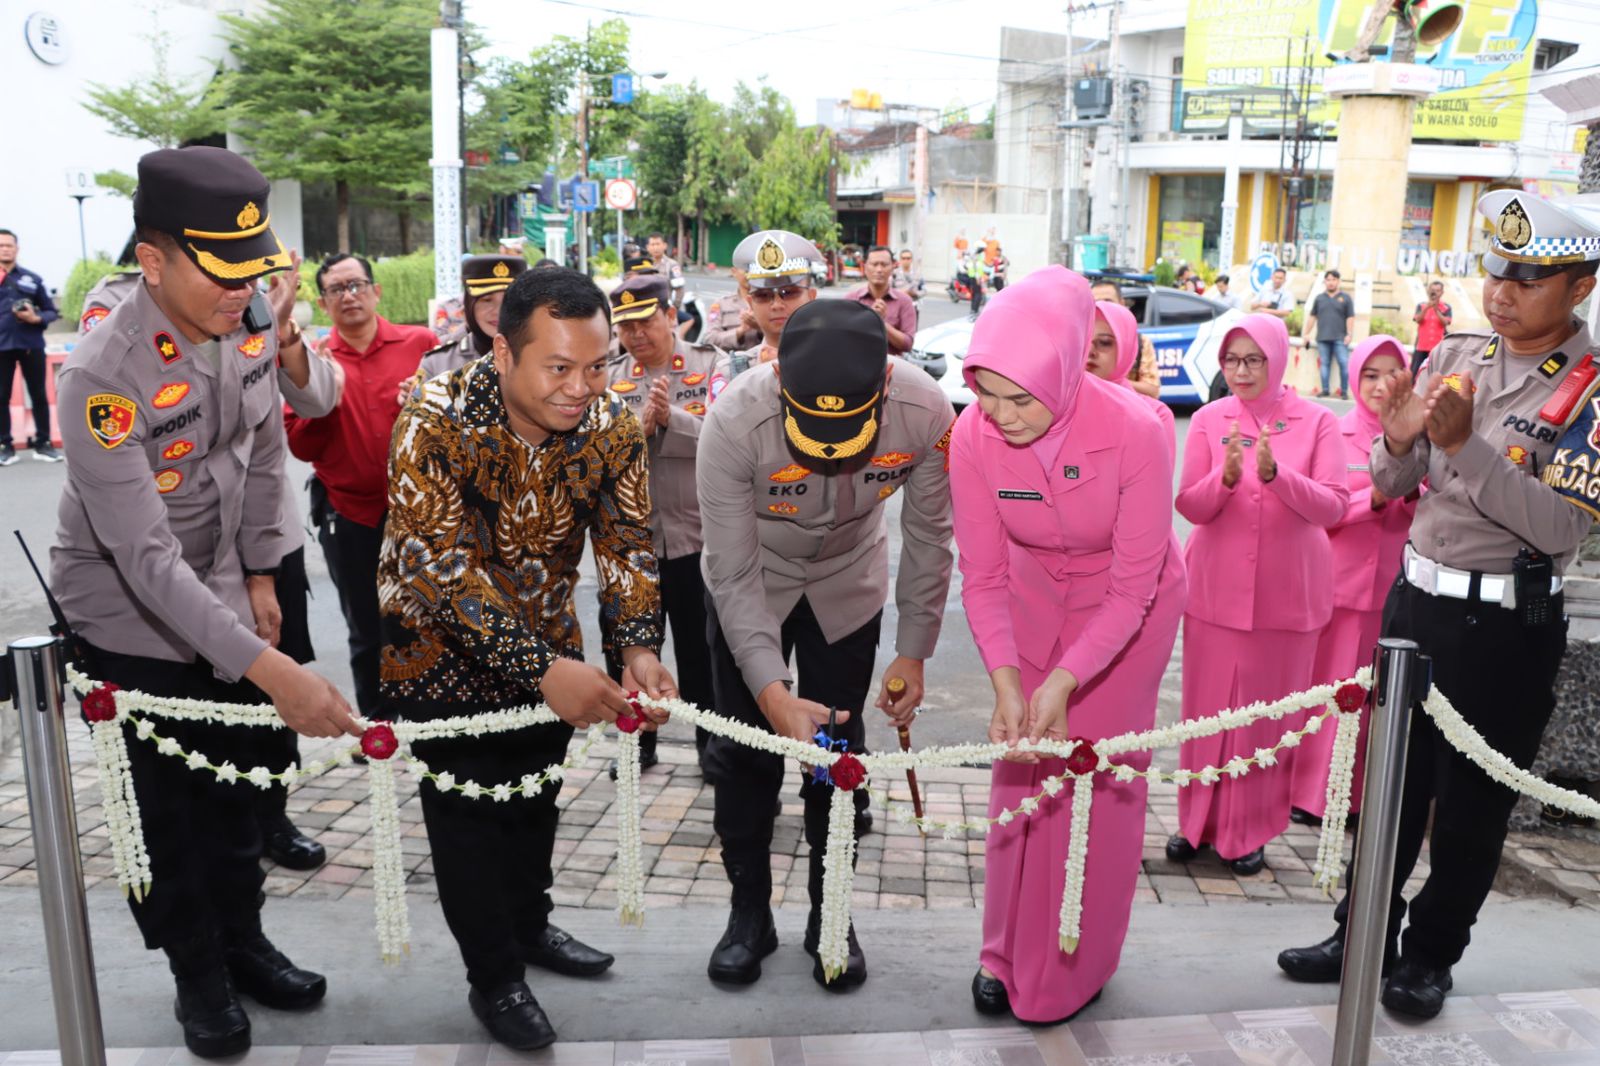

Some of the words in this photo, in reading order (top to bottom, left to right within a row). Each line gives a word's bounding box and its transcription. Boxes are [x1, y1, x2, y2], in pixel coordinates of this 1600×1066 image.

[1207, 66, 1263, 86] SOLUSI
[617, 79, 630, 99] P
[1428, 99, 1470, 113] SABLON
[1427, 114, 1465, 127] WARNA
[1502, 414, 1558, 444] POLRI
[768, 483, 808, 497] EKO
